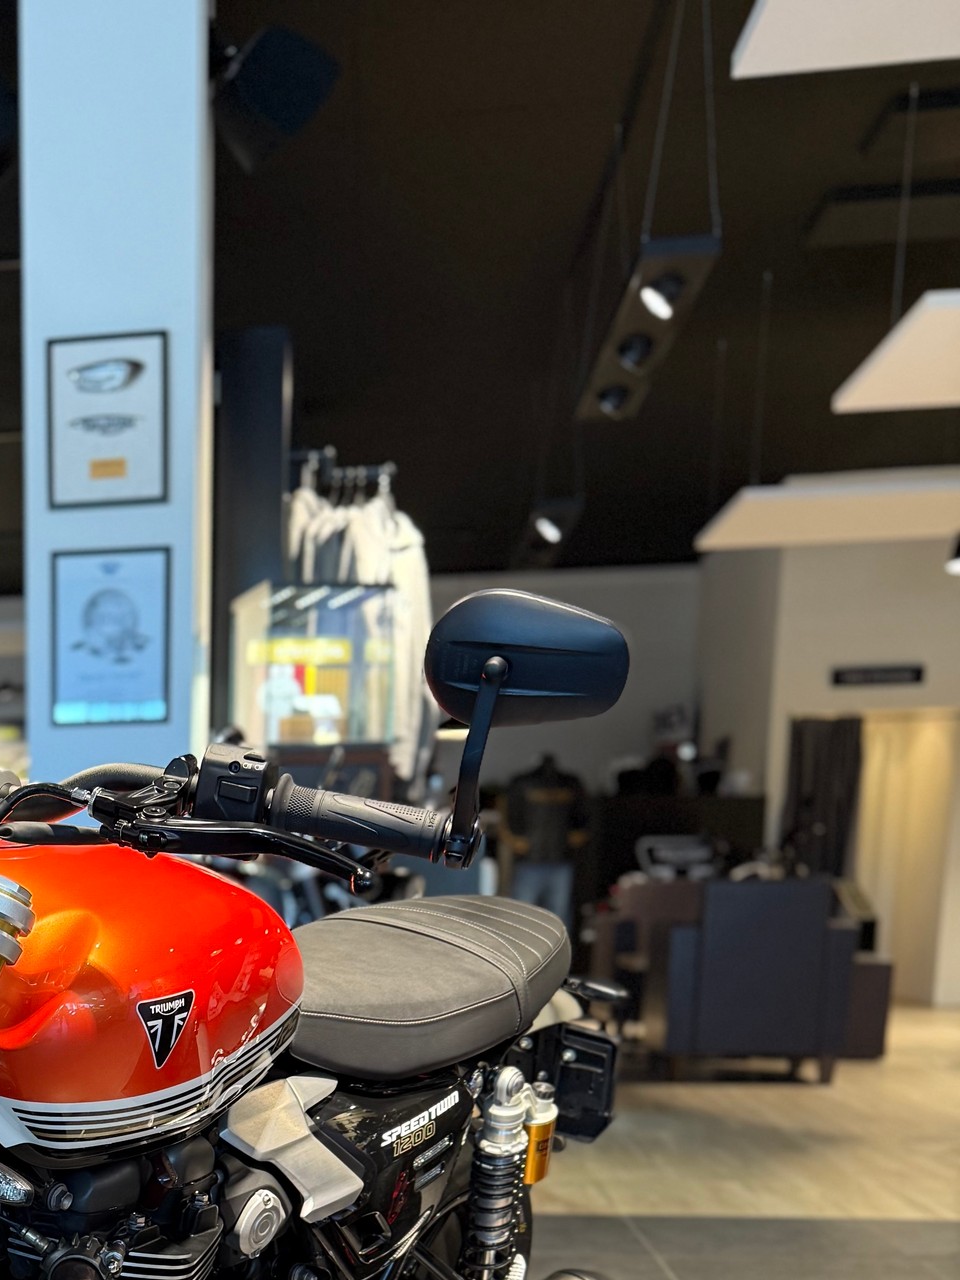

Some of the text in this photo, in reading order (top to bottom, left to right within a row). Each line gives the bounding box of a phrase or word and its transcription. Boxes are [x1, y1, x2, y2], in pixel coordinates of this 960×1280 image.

[149, 998, 186, 1016] TRIUMPH
[380, 1090, 460, 1148] SPEED TWIN
[393, 1120, 436, 1157] 1200
